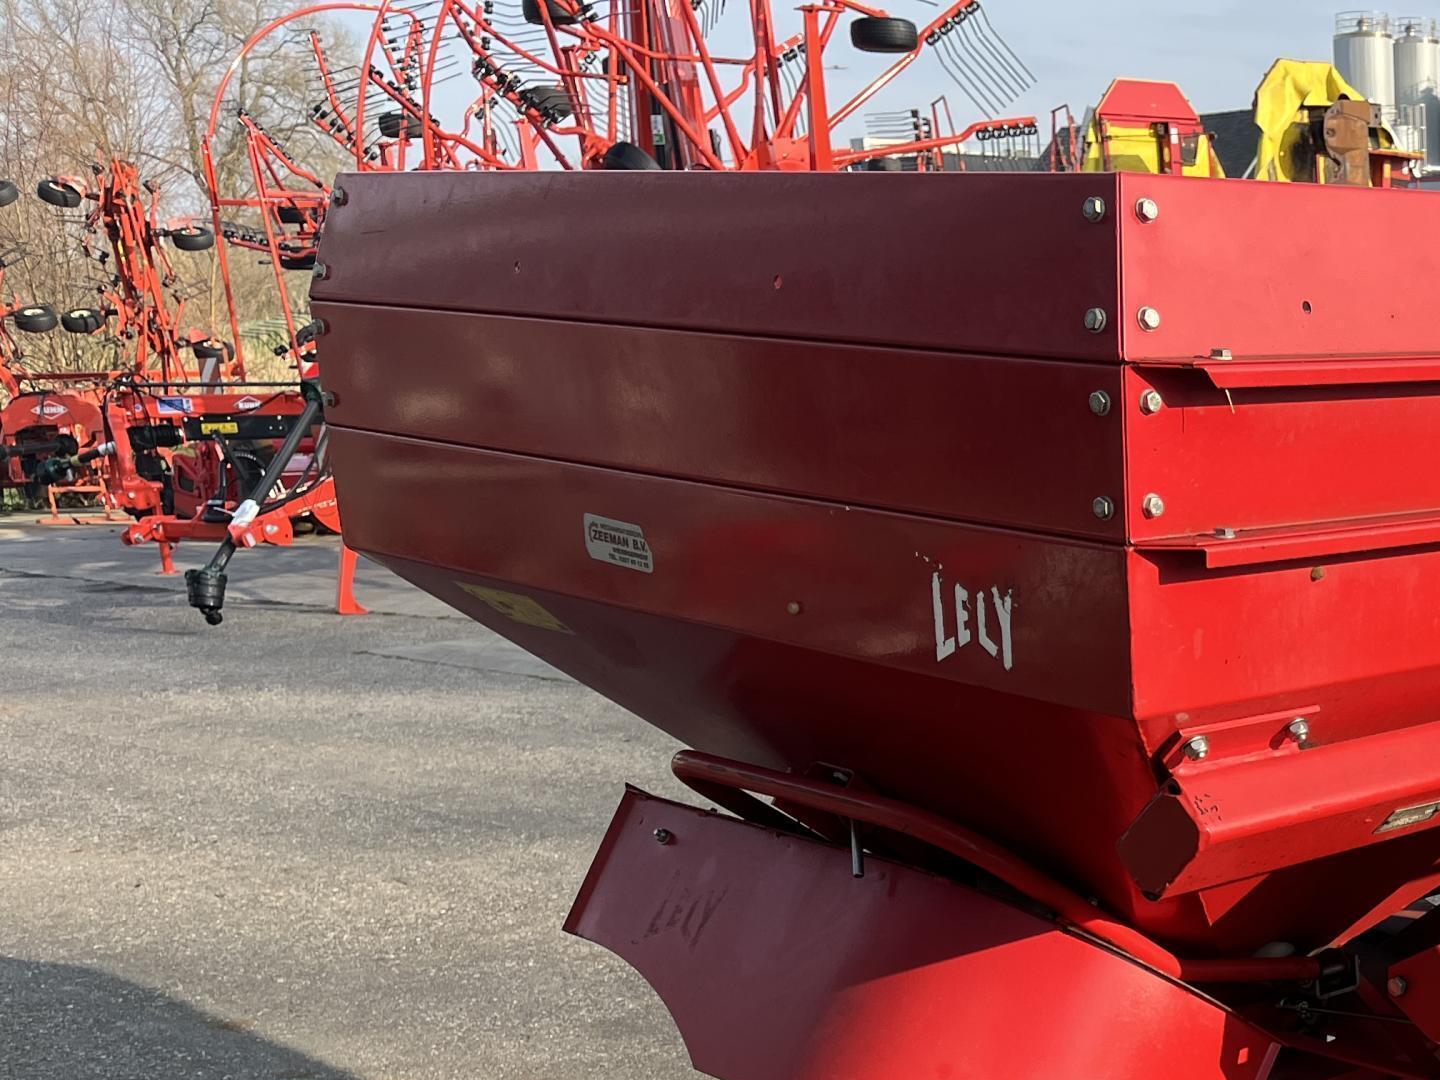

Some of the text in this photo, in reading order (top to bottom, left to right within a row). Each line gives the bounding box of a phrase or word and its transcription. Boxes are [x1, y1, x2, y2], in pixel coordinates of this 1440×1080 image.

[592, 529, 629, 548] ZEEMAN
[632, 539, 648, 553] B.V.
[932, 571, 1013, 672] LELY
